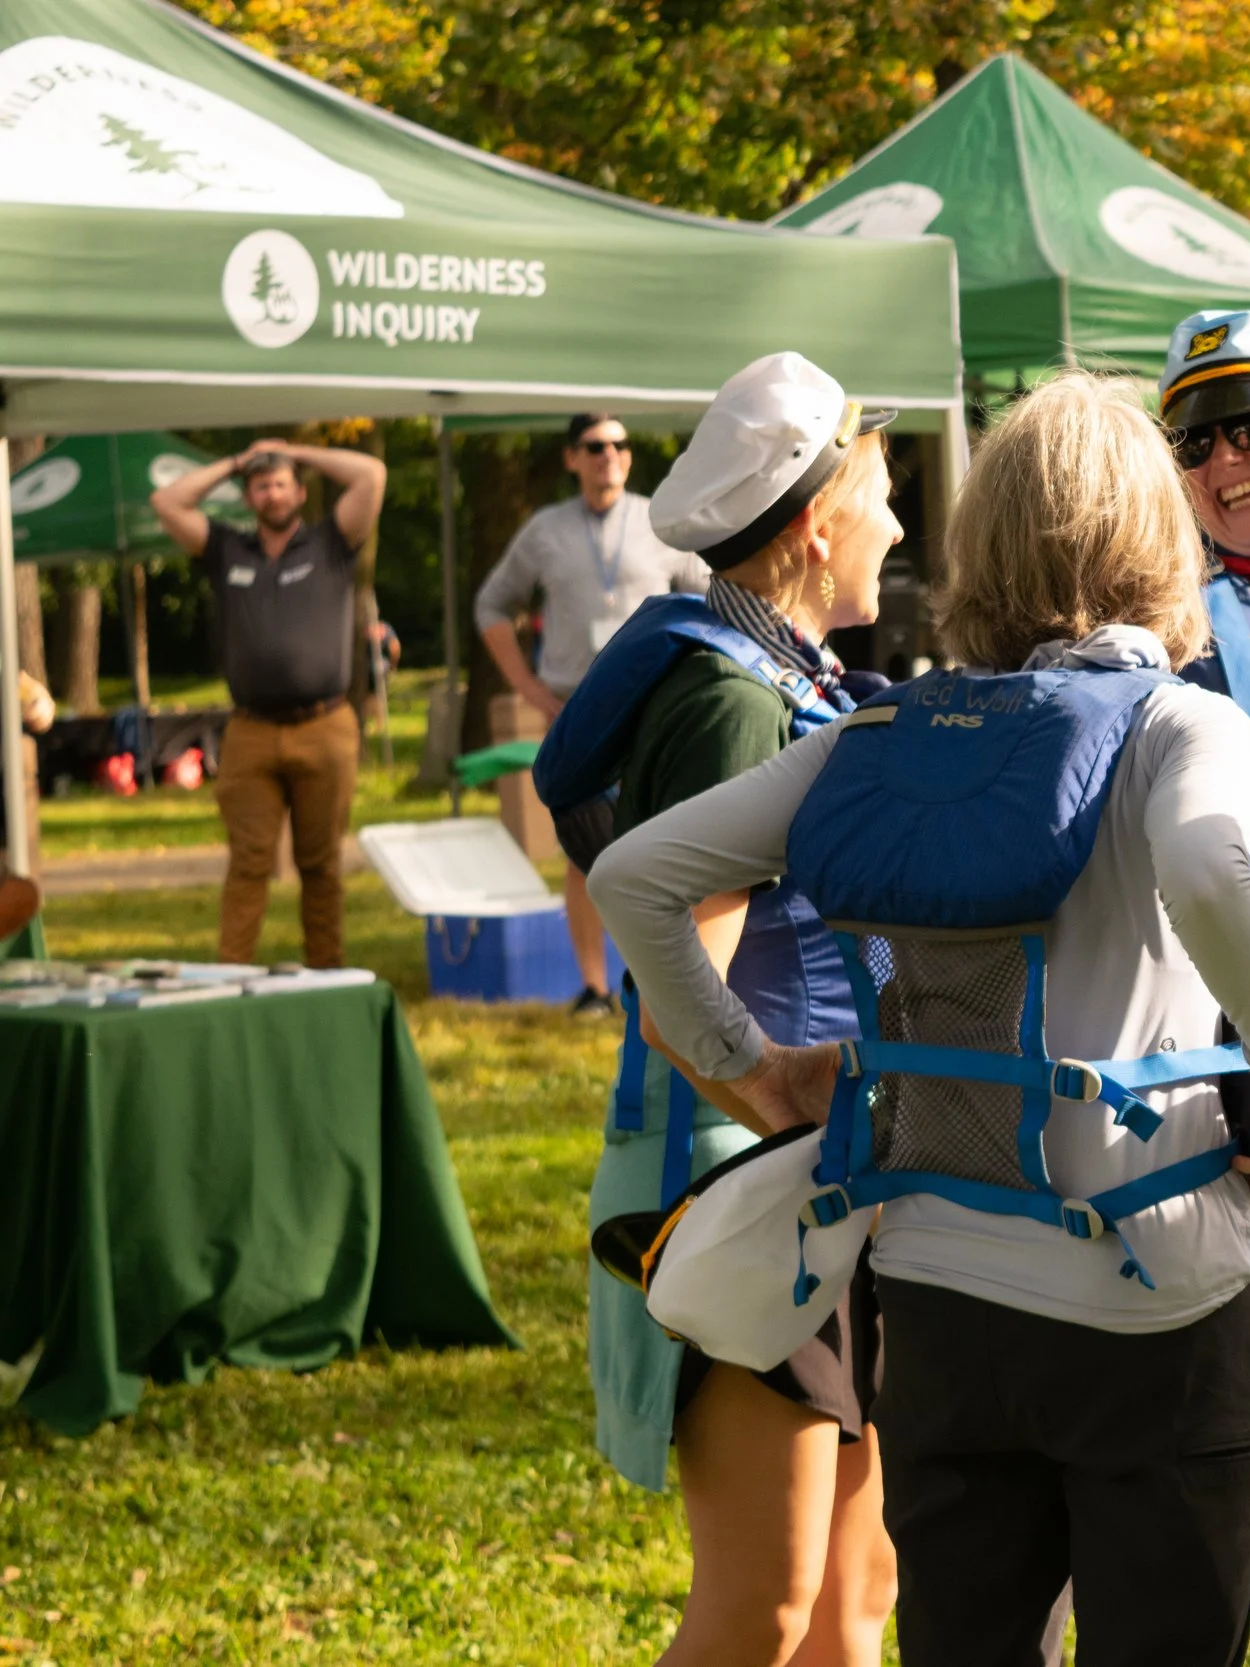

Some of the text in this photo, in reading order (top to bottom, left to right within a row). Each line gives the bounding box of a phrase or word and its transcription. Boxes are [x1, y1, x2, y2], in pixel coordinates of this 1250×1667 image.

[327, 249, 547, 297] WILDERNESS
[332, 301, 481, 347] INQUIRY
[930, 713, 983, 728] NRS
